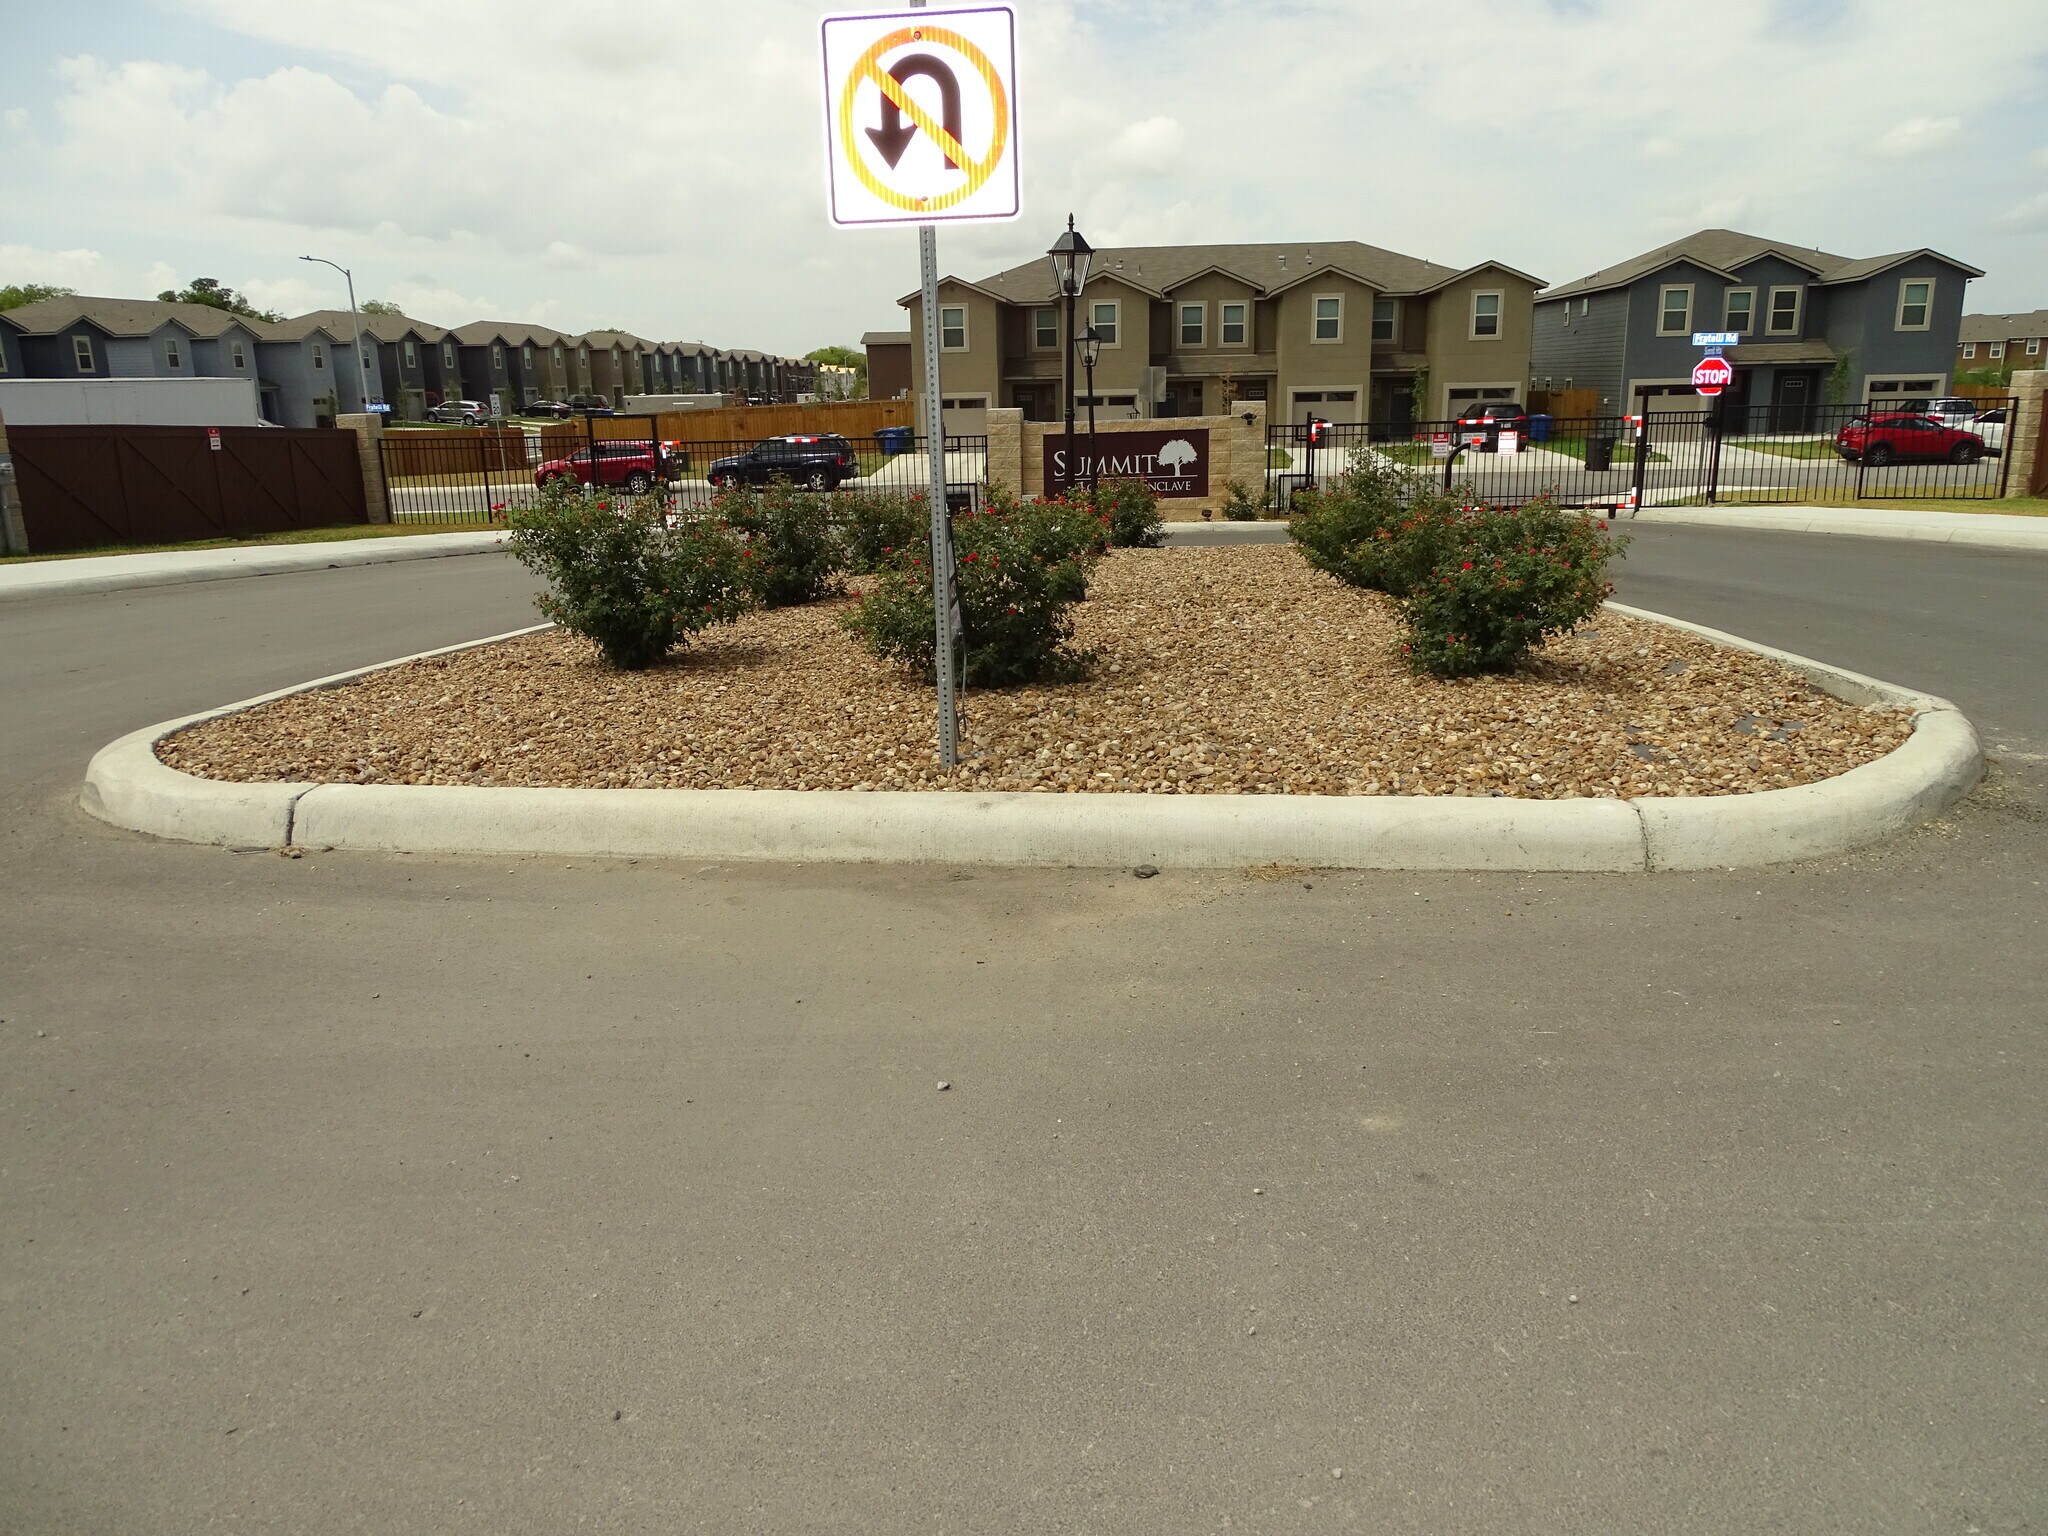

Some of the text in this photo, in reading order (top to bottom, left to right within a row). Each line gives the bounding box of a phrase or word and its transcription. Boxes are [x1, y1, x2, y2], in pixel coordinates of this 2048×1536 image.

[1695, 333, 1737, 343] Fratelli Rd
[1695, 369, 1728, 384] STOP
[493, 406, 500, 415] 20
[1148, 480, 1192, 492] NCLAVE
